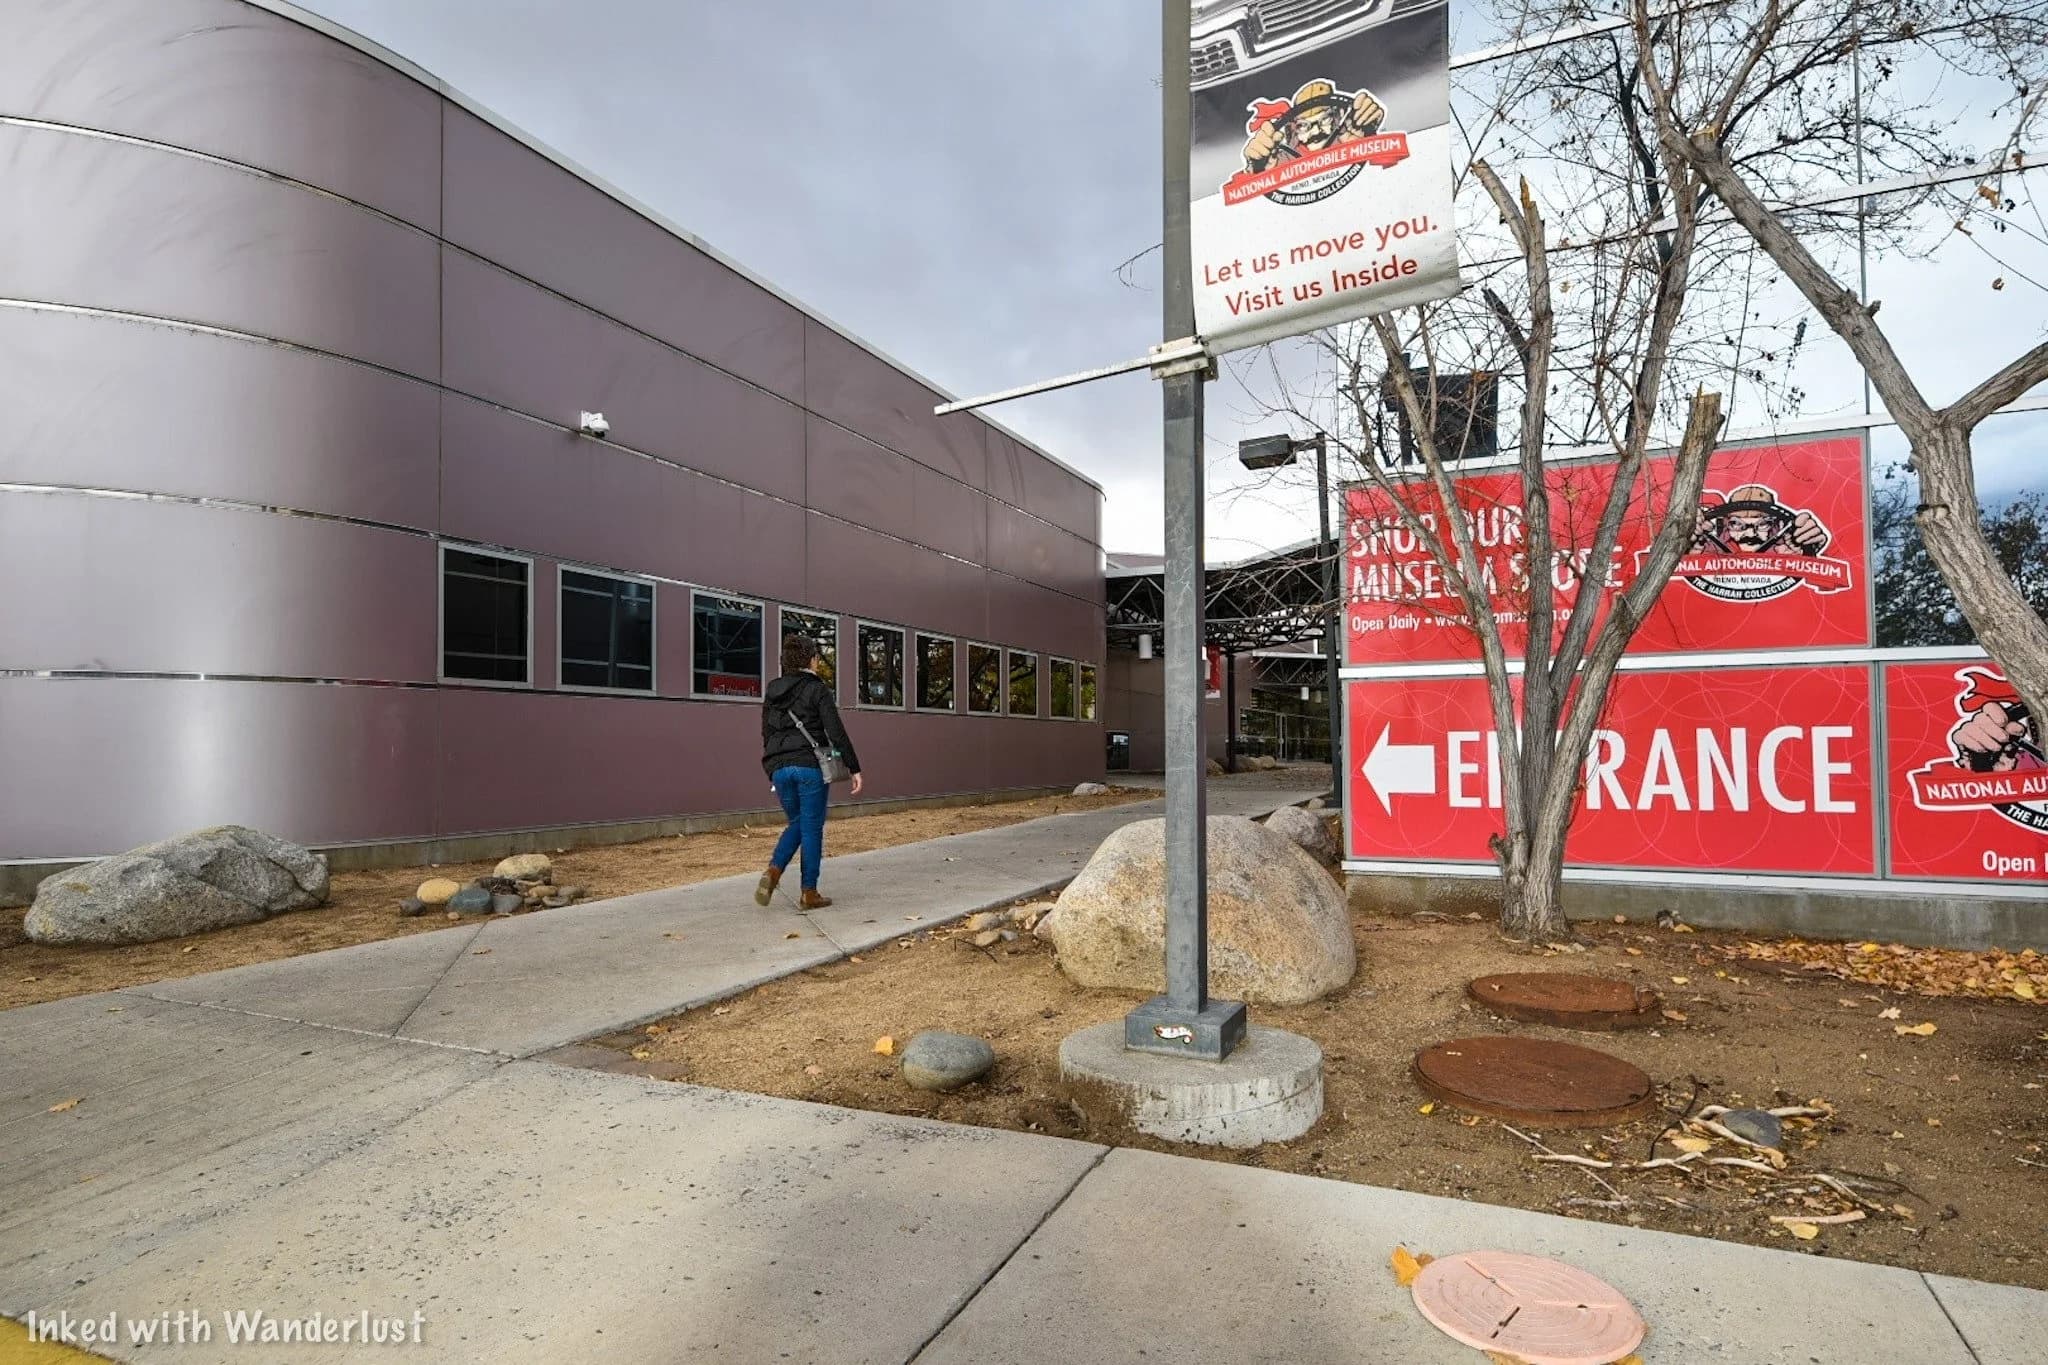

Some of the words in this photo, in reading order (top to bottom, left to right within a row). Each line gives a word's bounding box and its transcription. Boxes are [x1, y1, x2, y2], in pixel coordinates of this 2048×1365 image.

[1229, 177, 1277, 200] NATIONAL
[1280, 150, 1347, 181] AUTOMOBILE
[1350, 139, 1401, 158] MUSEUM
[1271, 192, 1286, 203] THE
[1285, 193, 1316, 205] HARRAH
[1317, 163, 1361, 198] COLLECTION
[1204, 259, 1243, 287] Let
[1252, 252, 1280, 275] us
[1289, 231, 1365, 265] move
[1375, 215, 1438, 251] you.
[1225, 285, 1284, 316] Visit
[1293, 280, 1323, 302] us
[1332, 254, 1418, 292] Inside
[1704, 558, 1782, 571] AUTOMOBILE
[1785, 560, 1842, 578] MUSEUM
[1692, 577, 1705, 590] THE
[1708, 586, 1743, 598] HARRAH
[1744, 577, 1797, 599] COLLECTION
[1741, 577, 1772, 585] NEVADA
[1352, 616, 1384, 634] Open
[1388, 612, 1420, 631] Daily
[1926, 779, 2017, 800] NATIONAL
[2006, 803, 2032, 822] THE
[1982, 850, 2036, 876] Open
